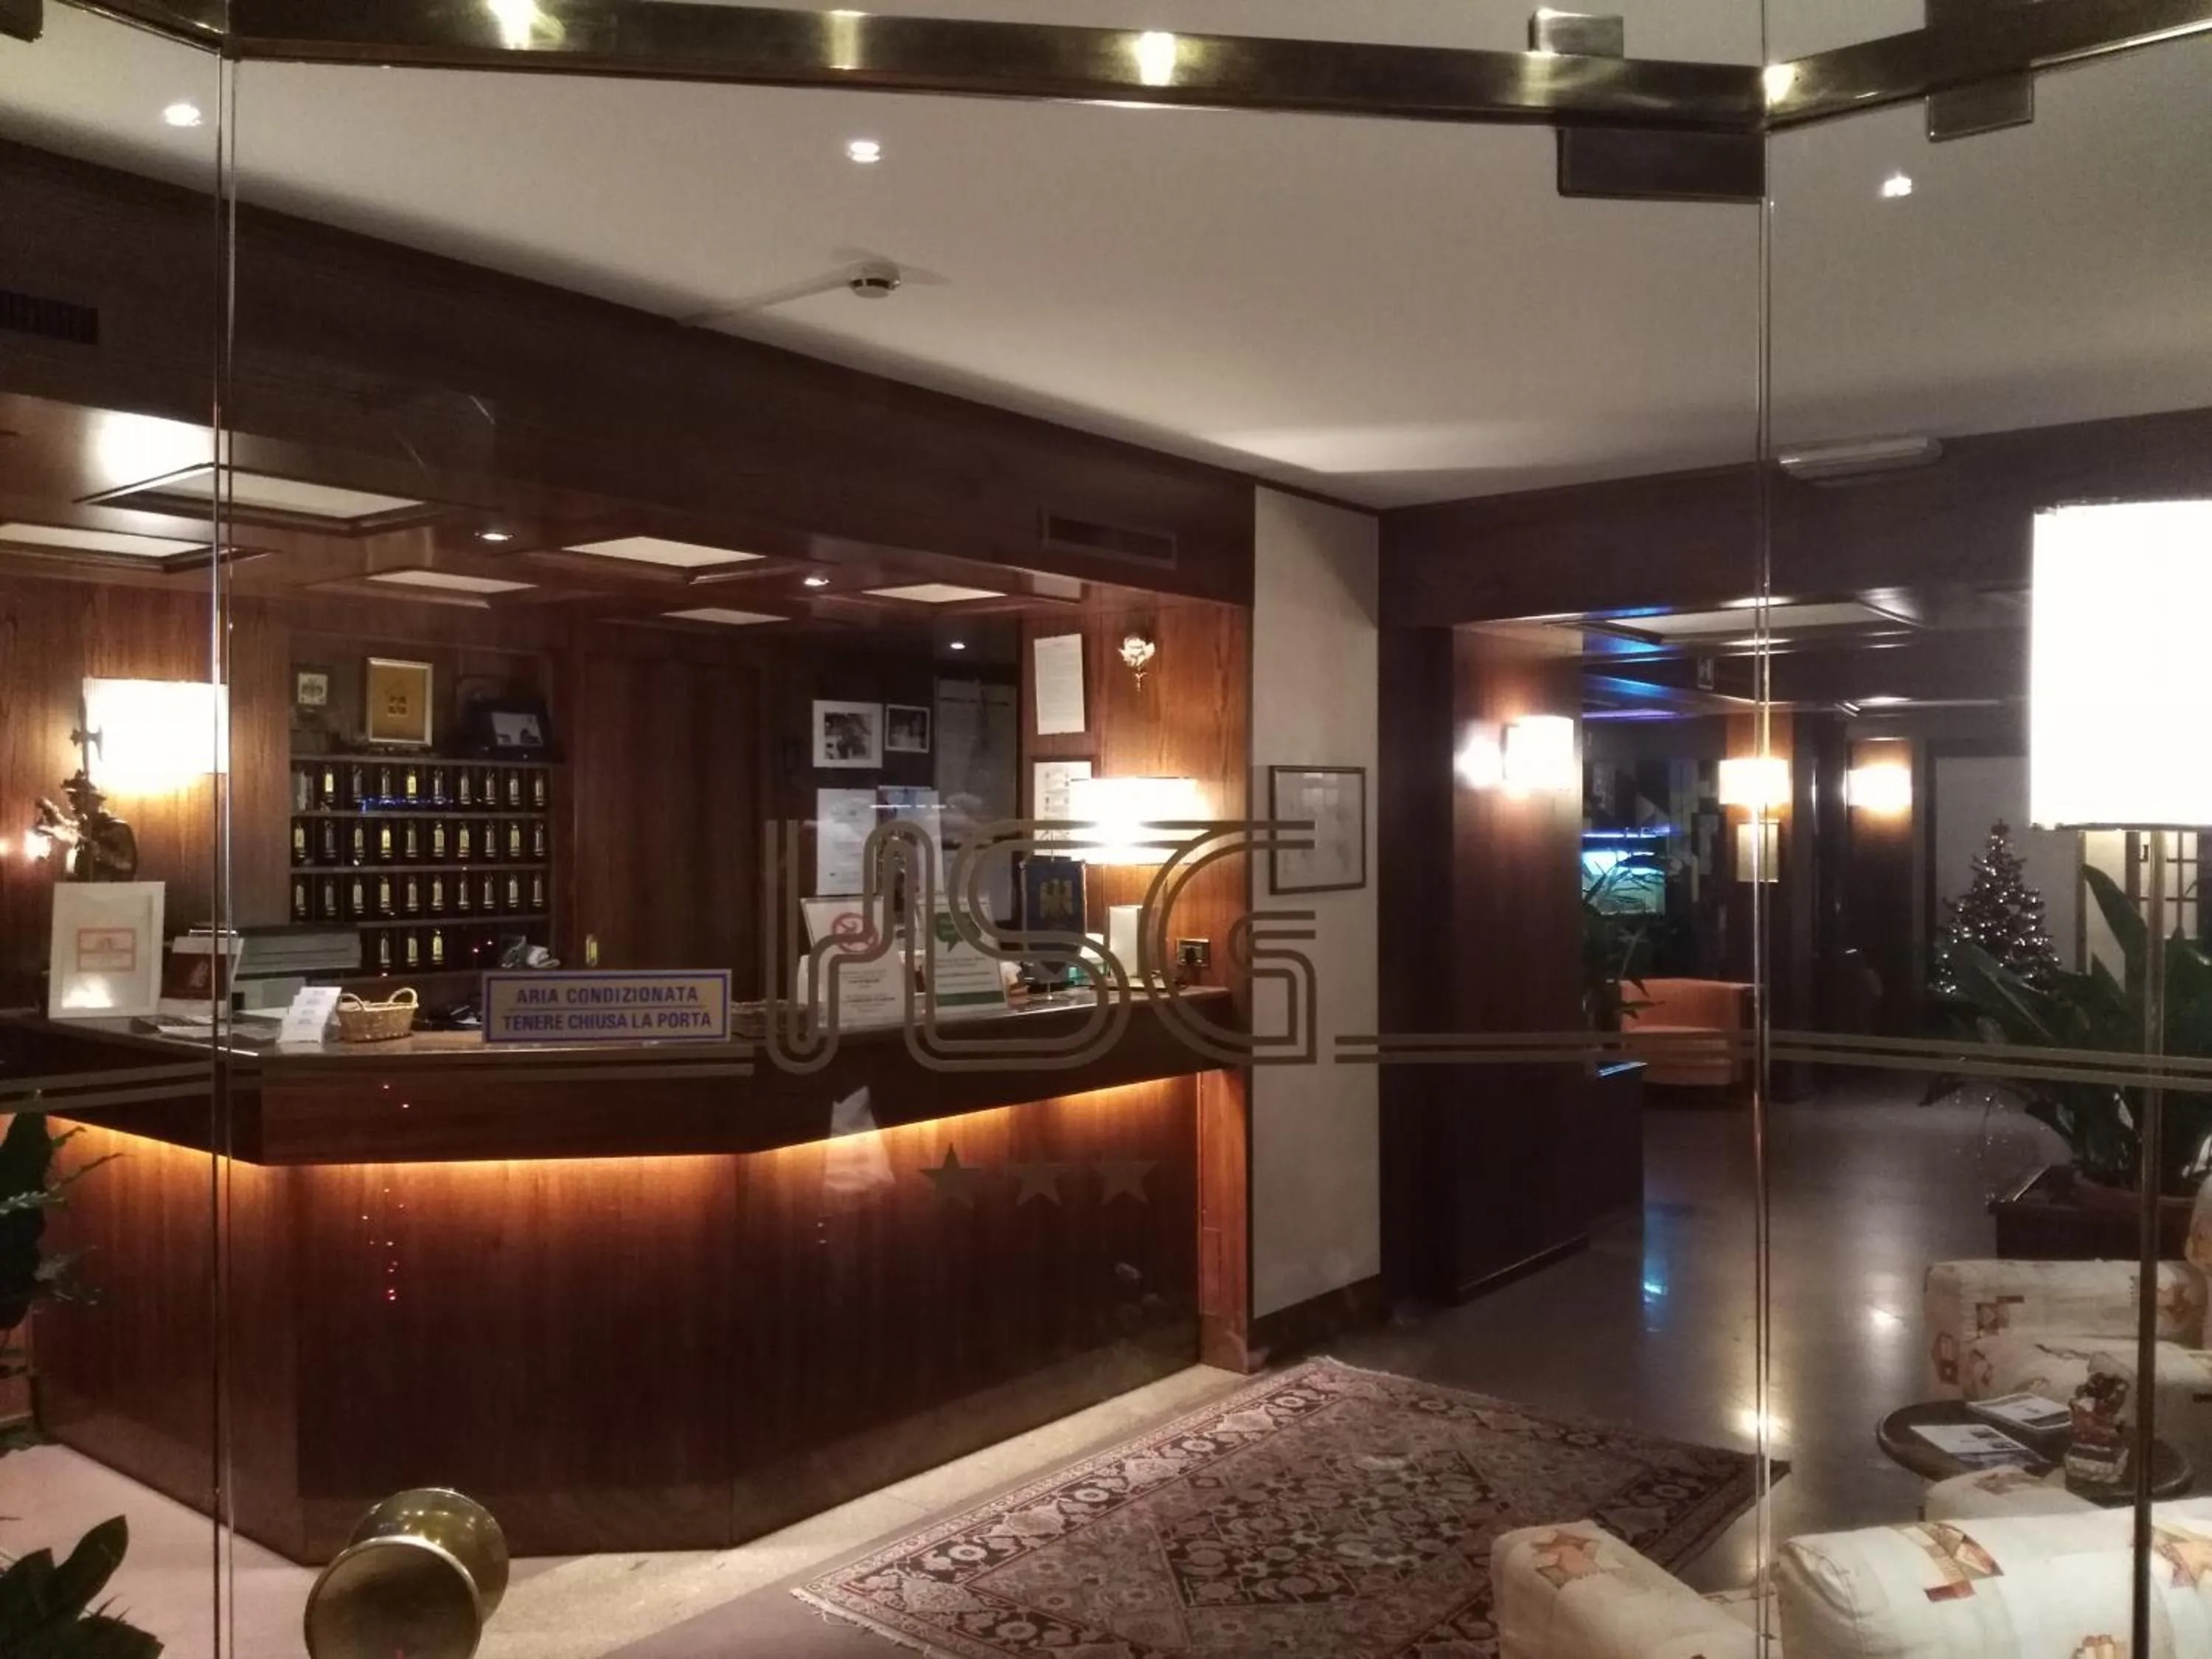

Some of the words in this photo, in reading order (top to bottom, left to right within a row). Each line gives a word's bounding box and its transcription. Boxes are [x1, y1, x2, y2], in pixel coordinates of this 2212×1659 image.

[517, 988, 559, 1004] ARIA
[566, 986, 698, 1004] CONDIZIONATA
[503, 1015, 563, 1031] TENERE
[568, 1014, 627, 1029] CHIUSA
[632, 1013, 653, 1029] LA
[657, 1012, 712, 1028] PORTA
